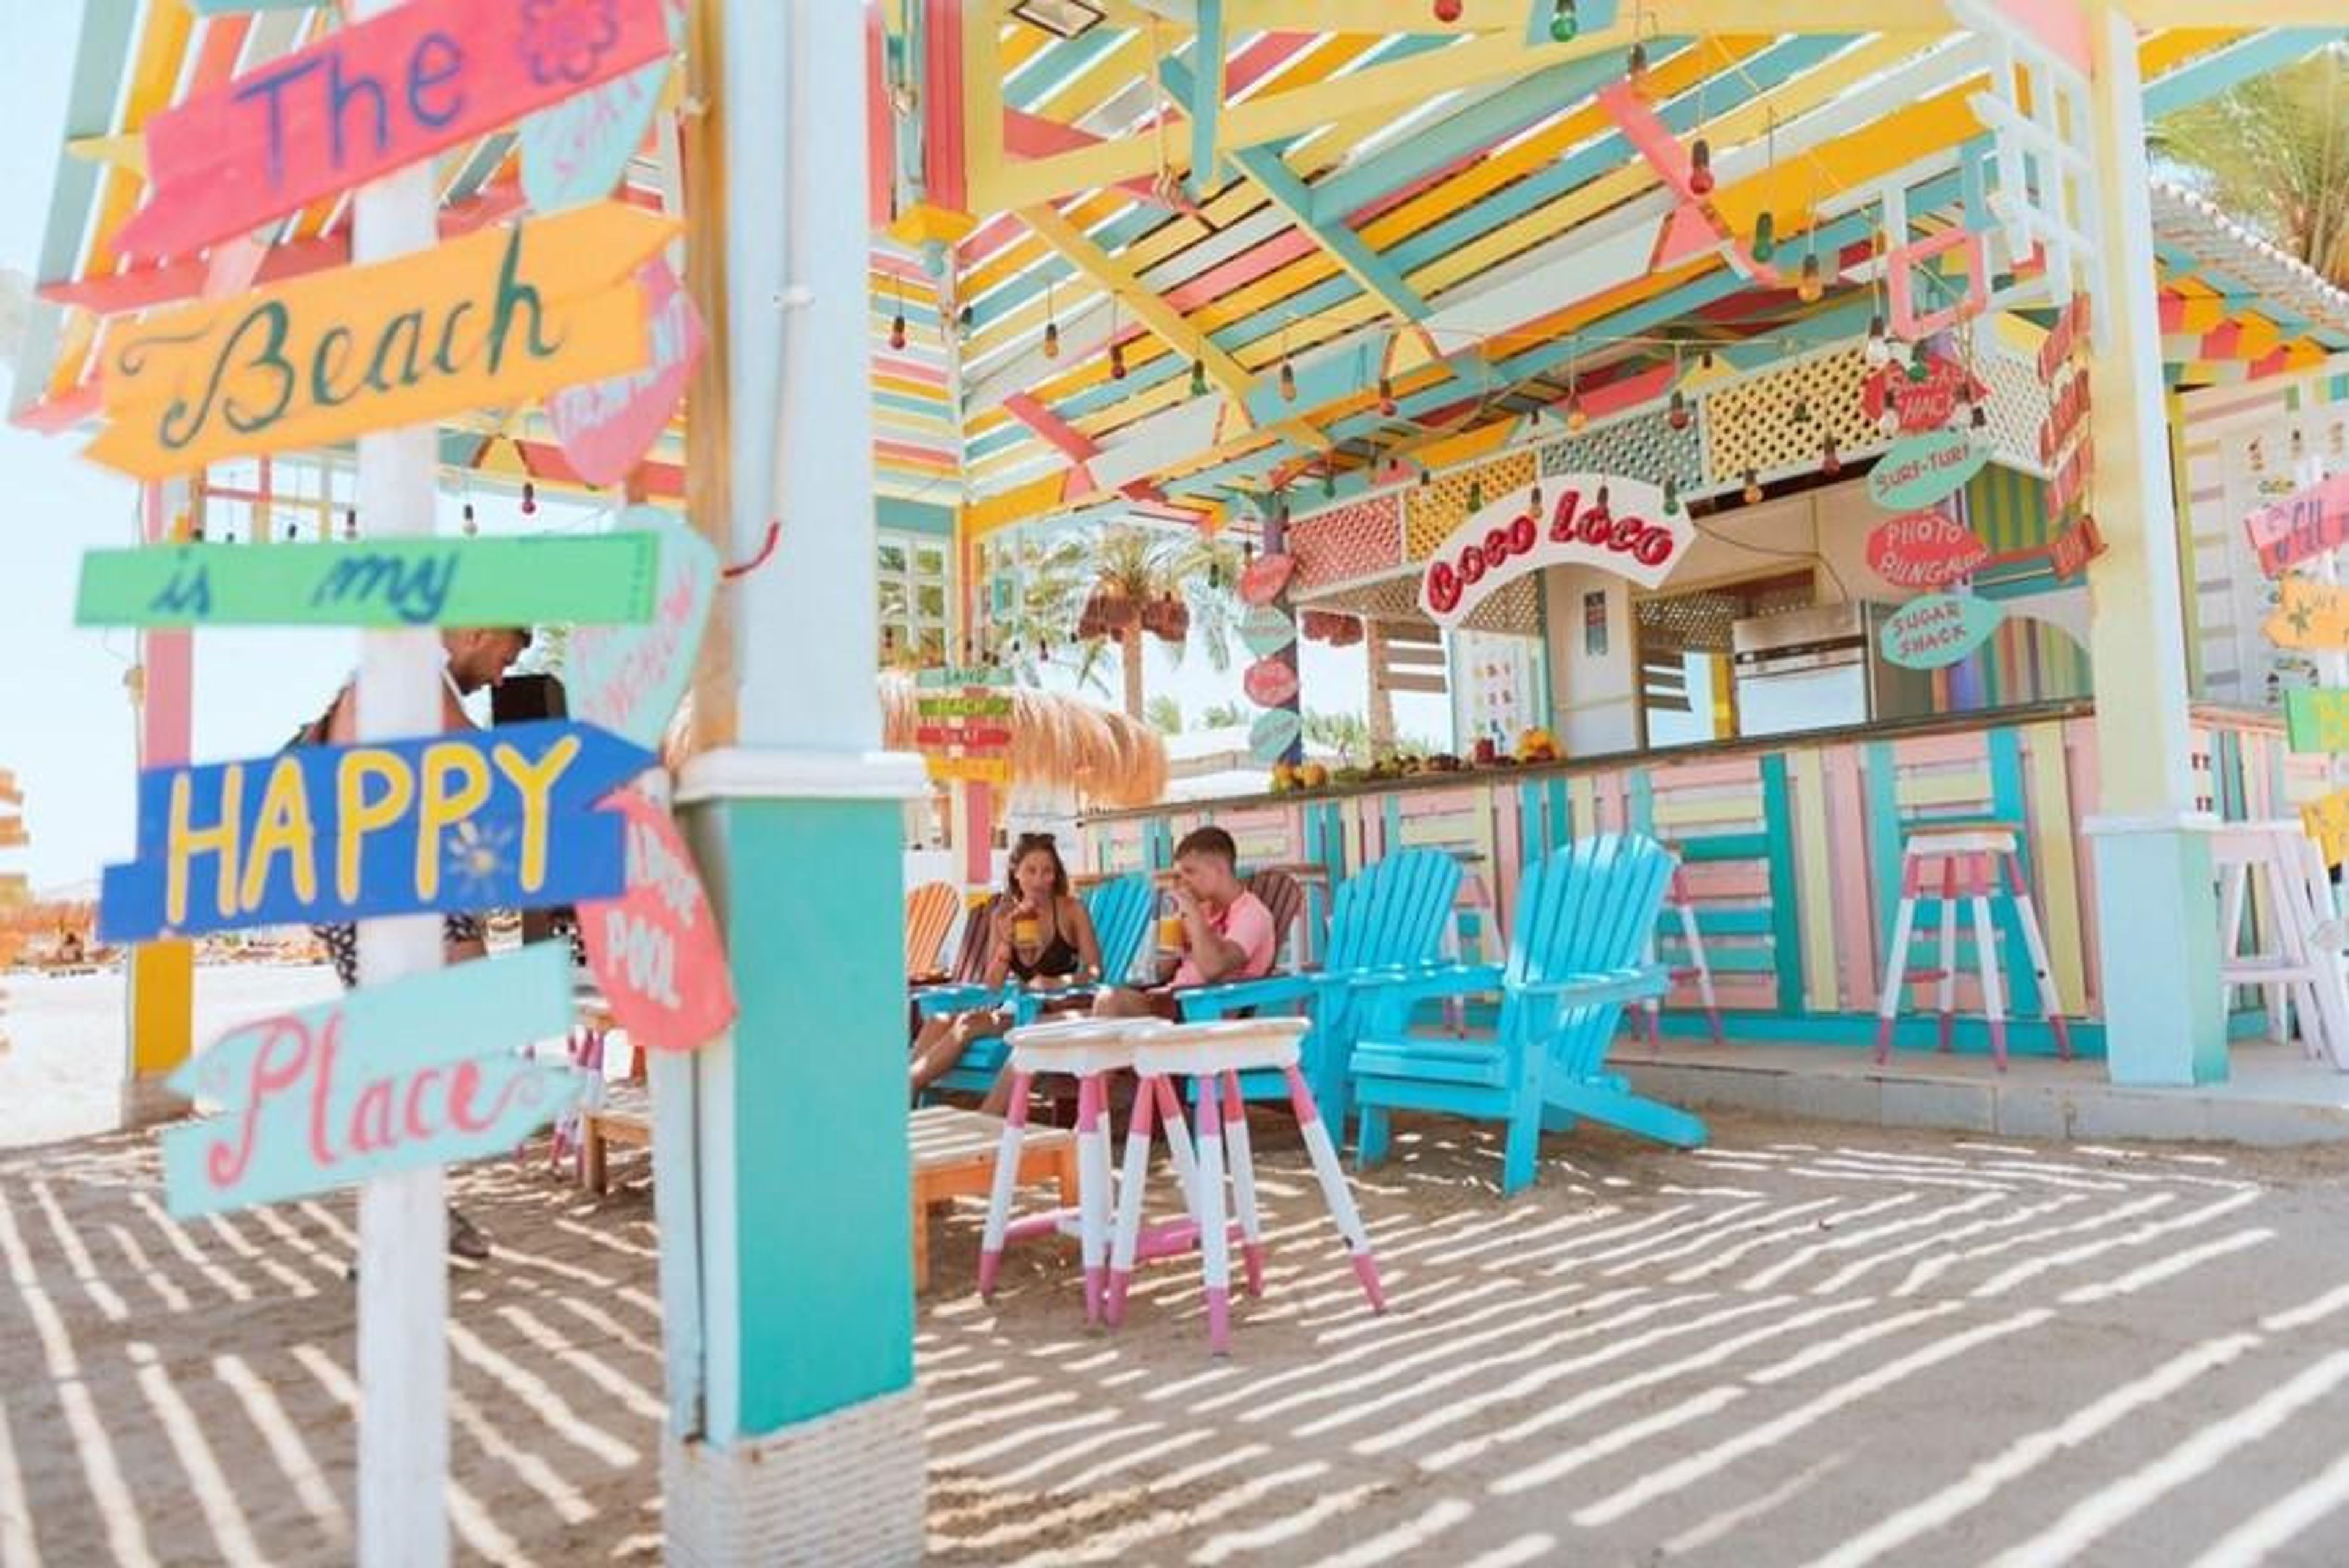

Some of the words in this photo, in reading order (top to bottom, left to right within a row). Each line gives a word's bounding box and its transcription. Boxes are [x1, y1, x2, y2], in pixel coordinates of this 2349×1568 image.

[232, 32, 466, 191] The
[158, 214, 564, 450] Beach
[150, 551, 212, 618] is
[311, 549, 461, 624] my
[1549, 489, 1674, 566] Loco
[1885, 515, 1962, 548] PHOTO
[1899, 626, 1967, 659] SHACK
[166, 735, 582, 926] HAPPY
[207, 1006, 514, 1190] Place
